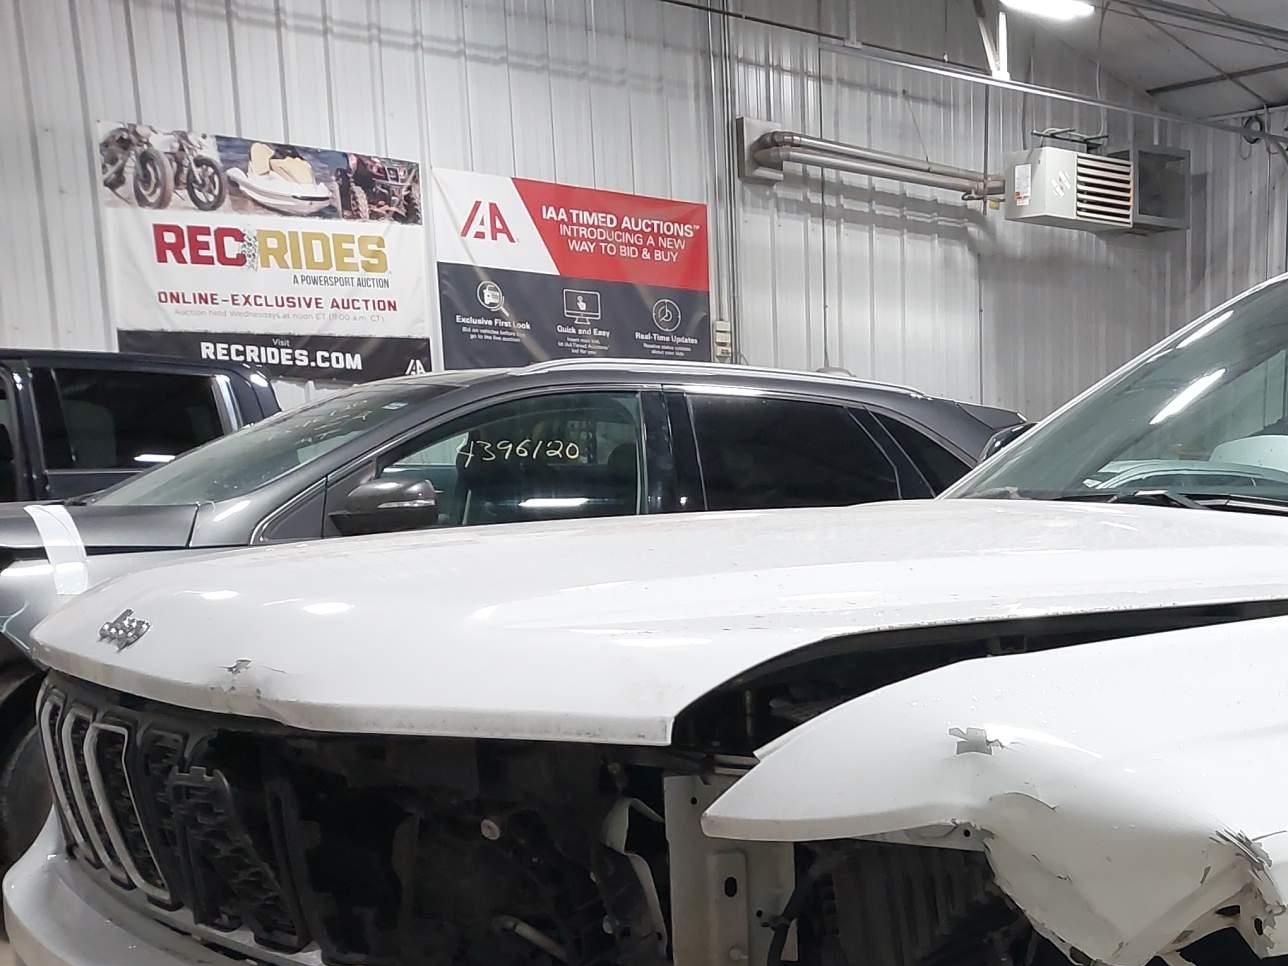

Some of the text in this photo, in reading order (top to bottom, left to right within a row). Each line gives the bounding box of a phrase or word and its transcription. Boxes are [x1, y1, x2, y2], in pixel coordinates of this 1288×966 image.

[541, 205, 567, 222] IAA
[570, 209, 618, 228] TIMED
[152, 223, 388, 273] REC RIDES
[559, 224, 686, 250] INTRODUCING A NEW
[568, 239, 680, 263] WAY TO BID & BUY
[293, 275, 390, 289] A POWERSPORT AUCTION
[158, 291, 398, 312] ONLINE-EXCLUSIVE AUCTION
[455, 314, 493, 326] Exclusive
[494, 318, 512, 328] First
[513, 321, 531, 331] Look
[557, 324, 610, 339] Quick and Easy
[272, 338, 290, 347] Visit
[635, 331, 698, 345] Real-Time Updates
[200, 341, 363, 370] RECRIDES.COM
[456, 438, 581, 468] 4396120
